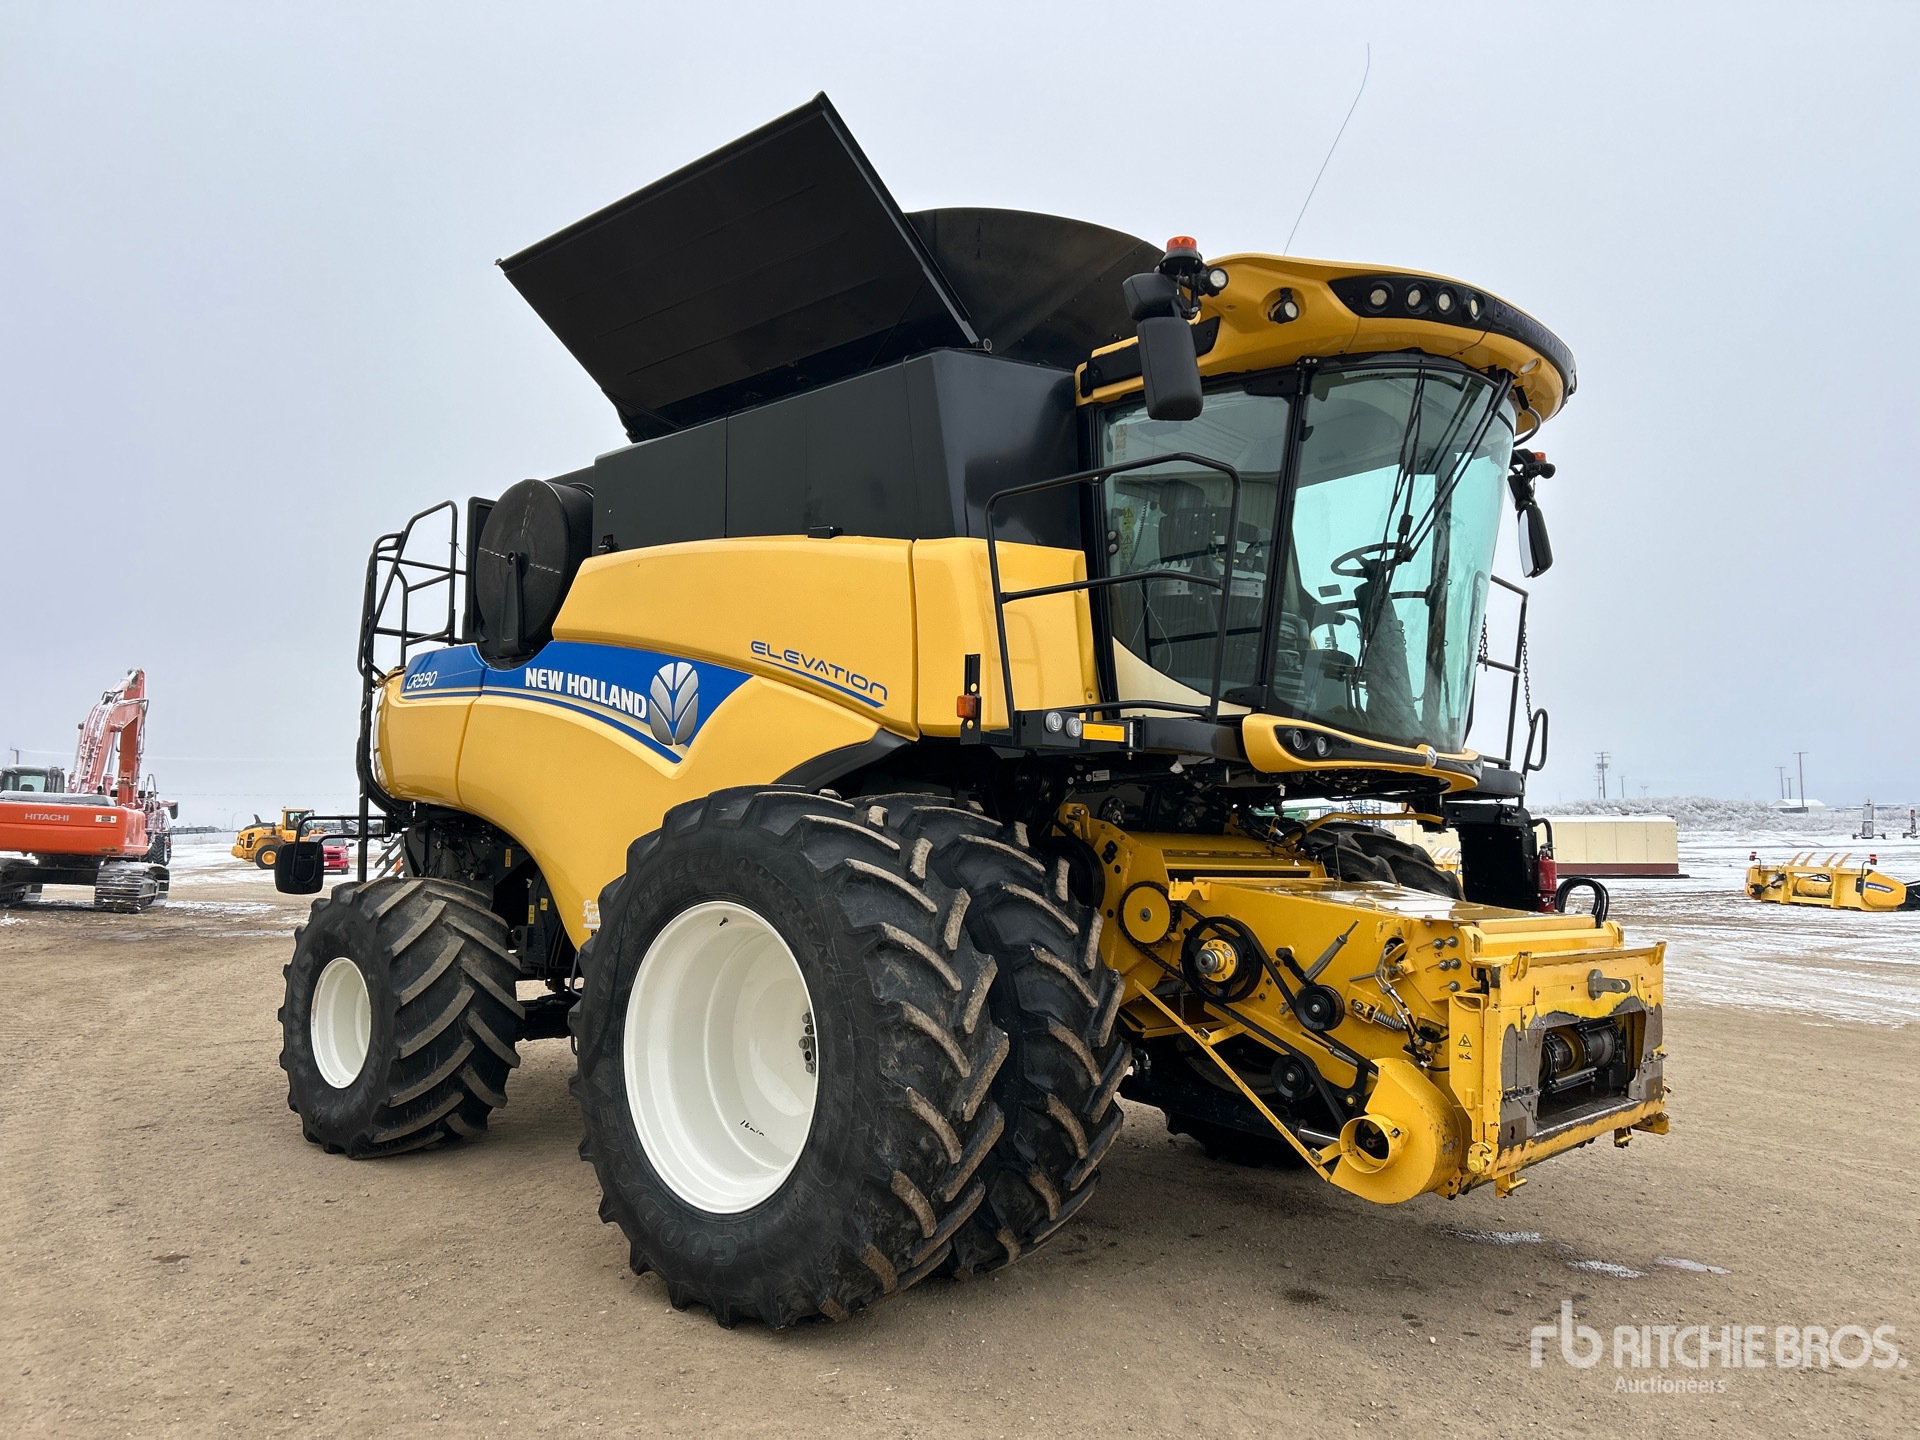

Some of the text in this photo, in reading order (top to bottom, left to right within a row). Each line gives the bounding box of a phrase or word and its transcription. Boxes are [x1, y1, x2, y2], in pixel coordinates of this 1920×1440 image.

[525, 667, 647, 719] NEW HOLLAND
[751, 640, 888, 701] ELEVATION
[24, 812, 70, 822] HITACHI
